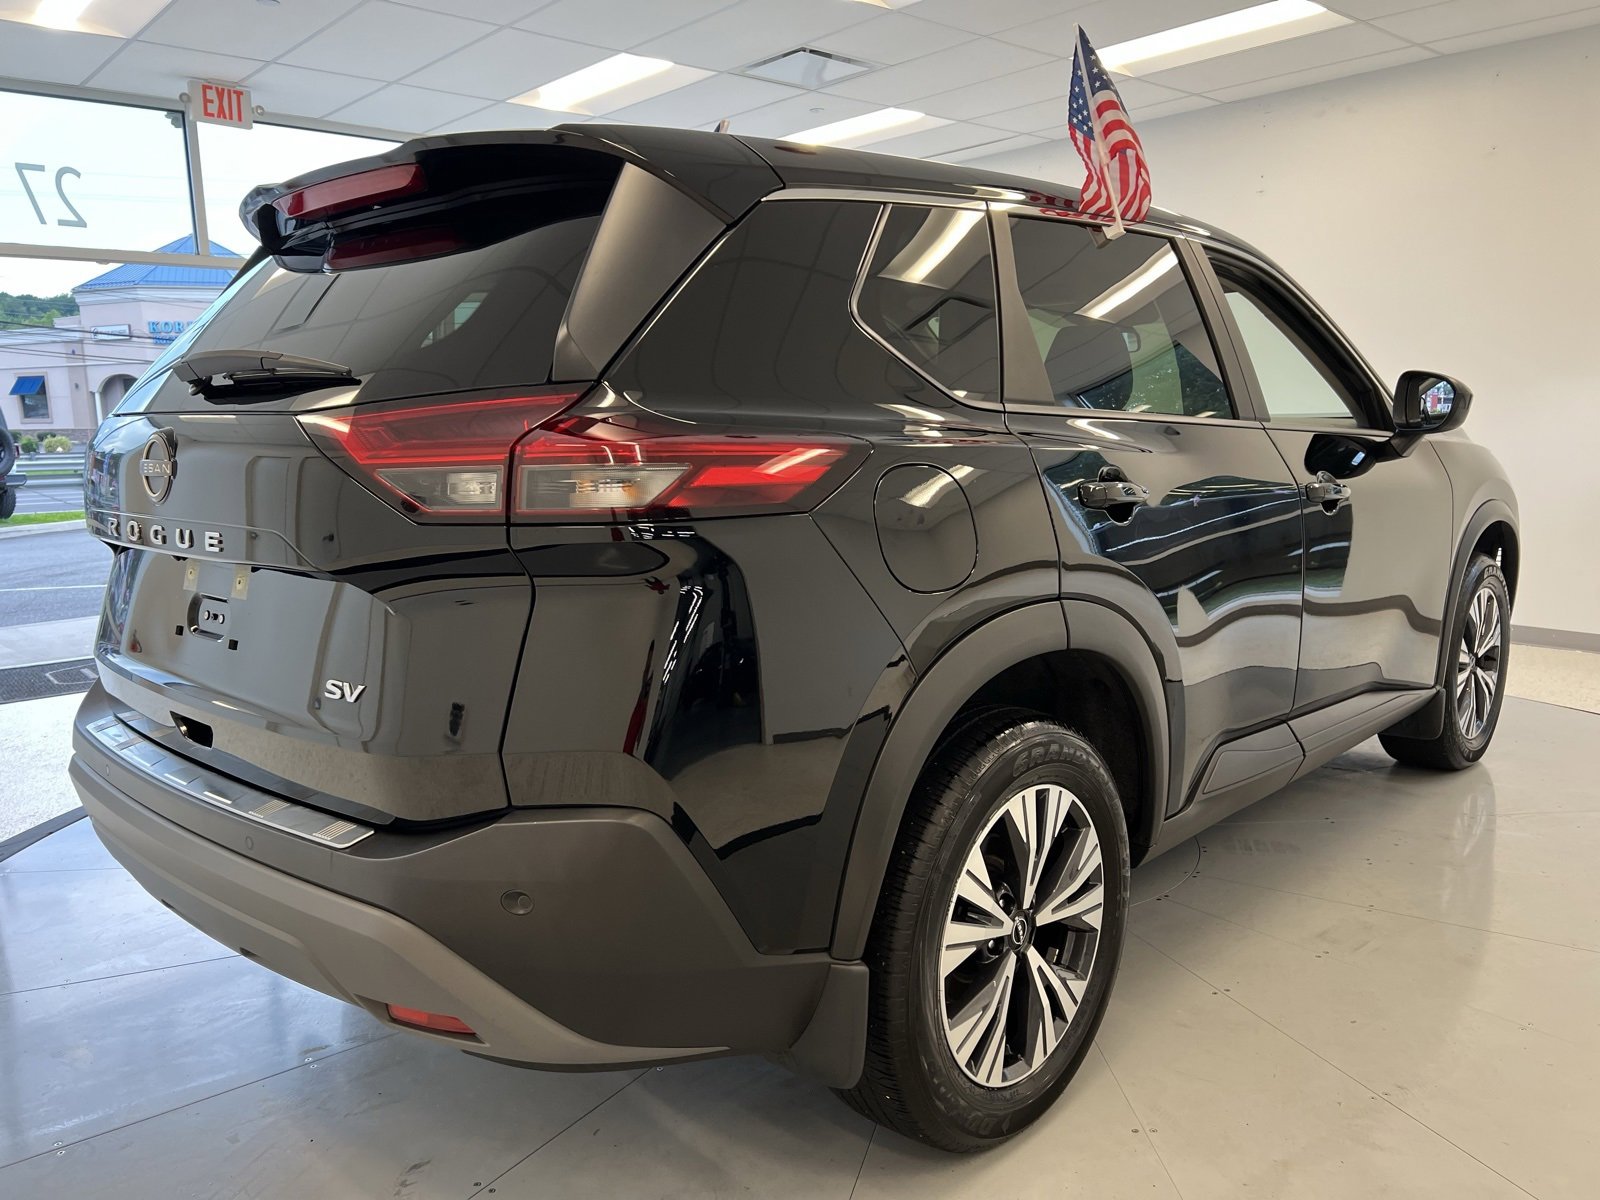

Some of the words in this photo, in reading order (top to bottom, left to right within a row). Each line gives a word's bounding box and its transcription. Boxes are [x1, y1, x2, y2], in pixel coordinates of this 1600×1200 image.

[202, 83, 244, 122] EXIT
[107, 517, 223, 553] ROGUE
[324, 679, 366, 703] SV
